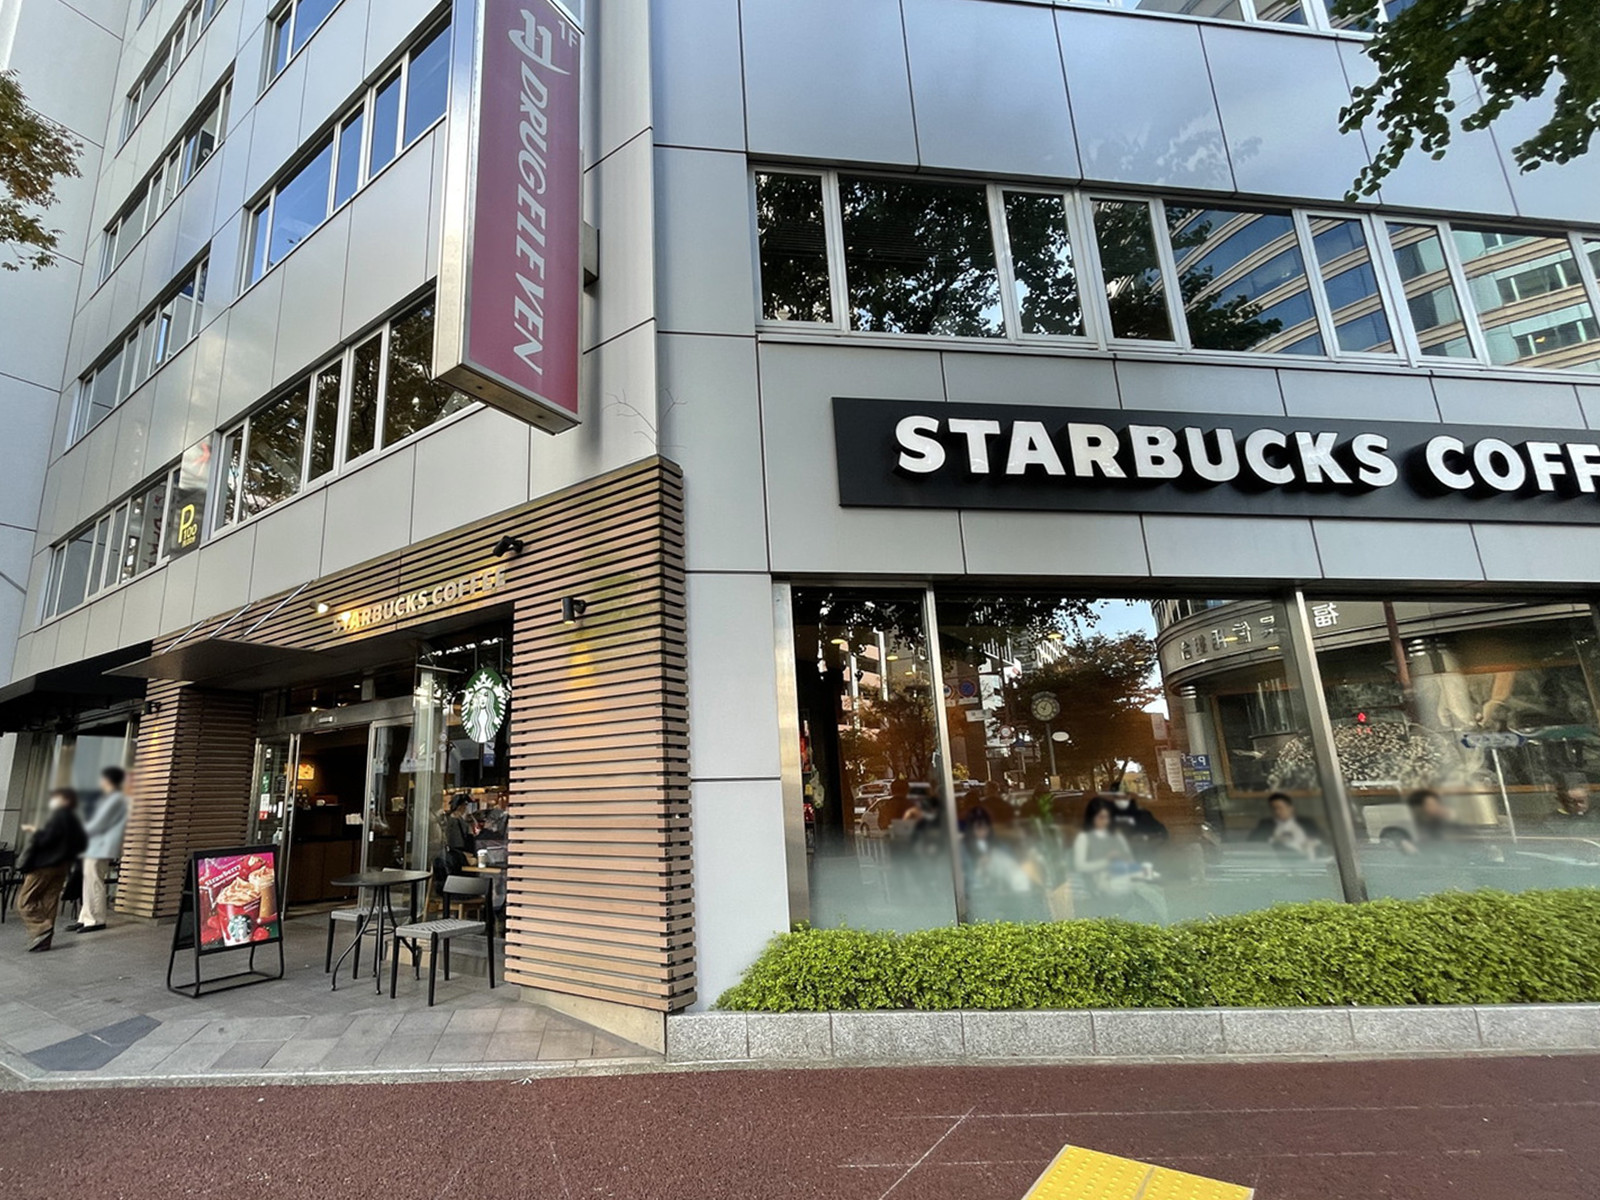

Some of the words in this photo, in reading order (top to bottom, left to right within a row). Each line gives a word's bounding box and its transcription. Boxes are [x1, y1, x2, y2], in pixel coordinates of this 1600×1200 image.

[557, 19, 578, 48] 1F
[895, 415, 1398, 487] STARBUCKS
[1426, 435, 1600, 493] COFF
[431, 566, 507, 605] COFFEE
